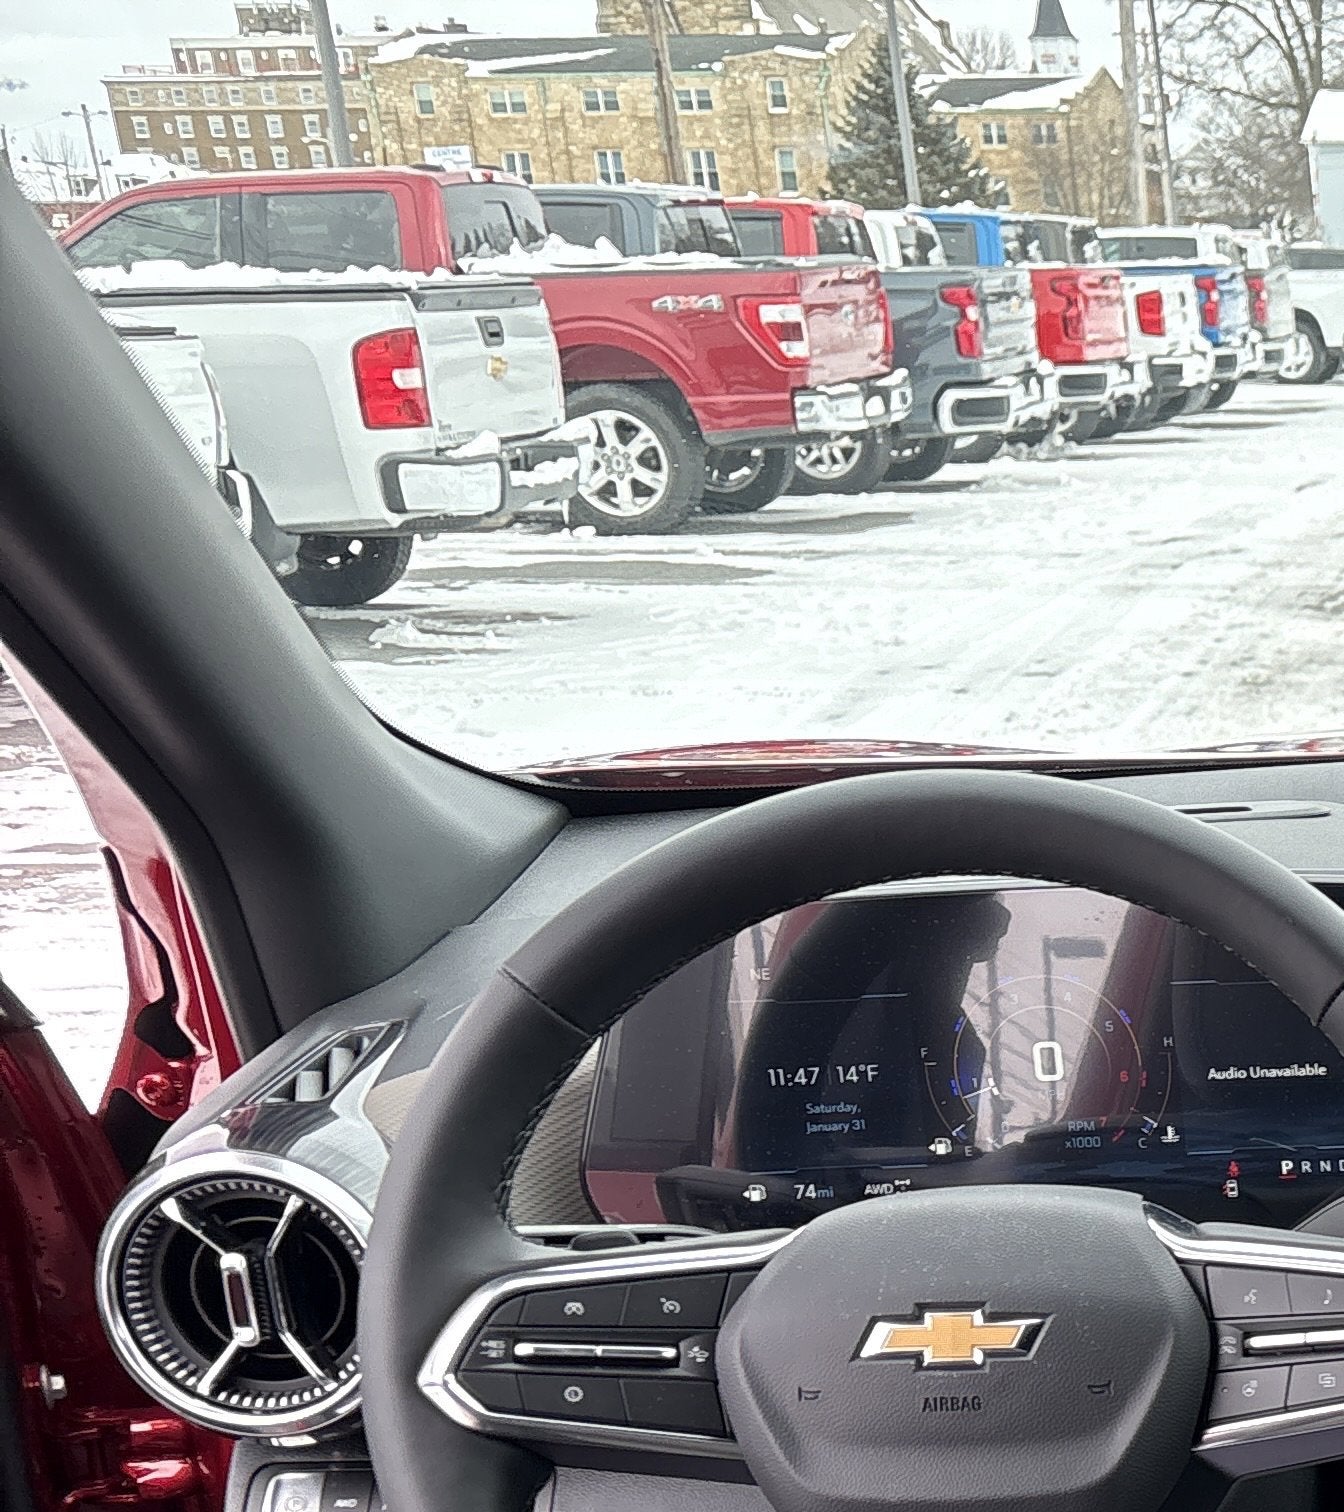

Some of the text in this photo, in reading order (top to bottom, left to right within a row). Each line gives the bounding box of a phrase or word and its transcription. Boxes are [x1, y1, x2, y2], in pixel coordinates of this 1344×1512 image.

[1163, 1036, 1174, 1047] H
[921, 1047, 928, 1058] F
[1032, 1041, 1064, 1081] 0
[767, 1064, 878, 1087] 11:47 14°F
[1119, 1070, 1129, 1082] 6
[1208, 1063, 1327, 1080] Audio Unavailable
[806, 1119, 866, 1135] January 31
[1068, 1120, 1096, 1132] RPM
[1065, 1136, 1101, 1149] x1000
[1138, 1137, 1148, 1149] C
[964, 1145, 973, 1157] E
[1280, 1160, 1293, 1175] P
[1301, 1160, 1312, 1173] R
[1319, 1160, 1332, 1173] N
[864, 1182, 894, 1195] AWD
[921, 1395, 982, 1412] AIRBAG
